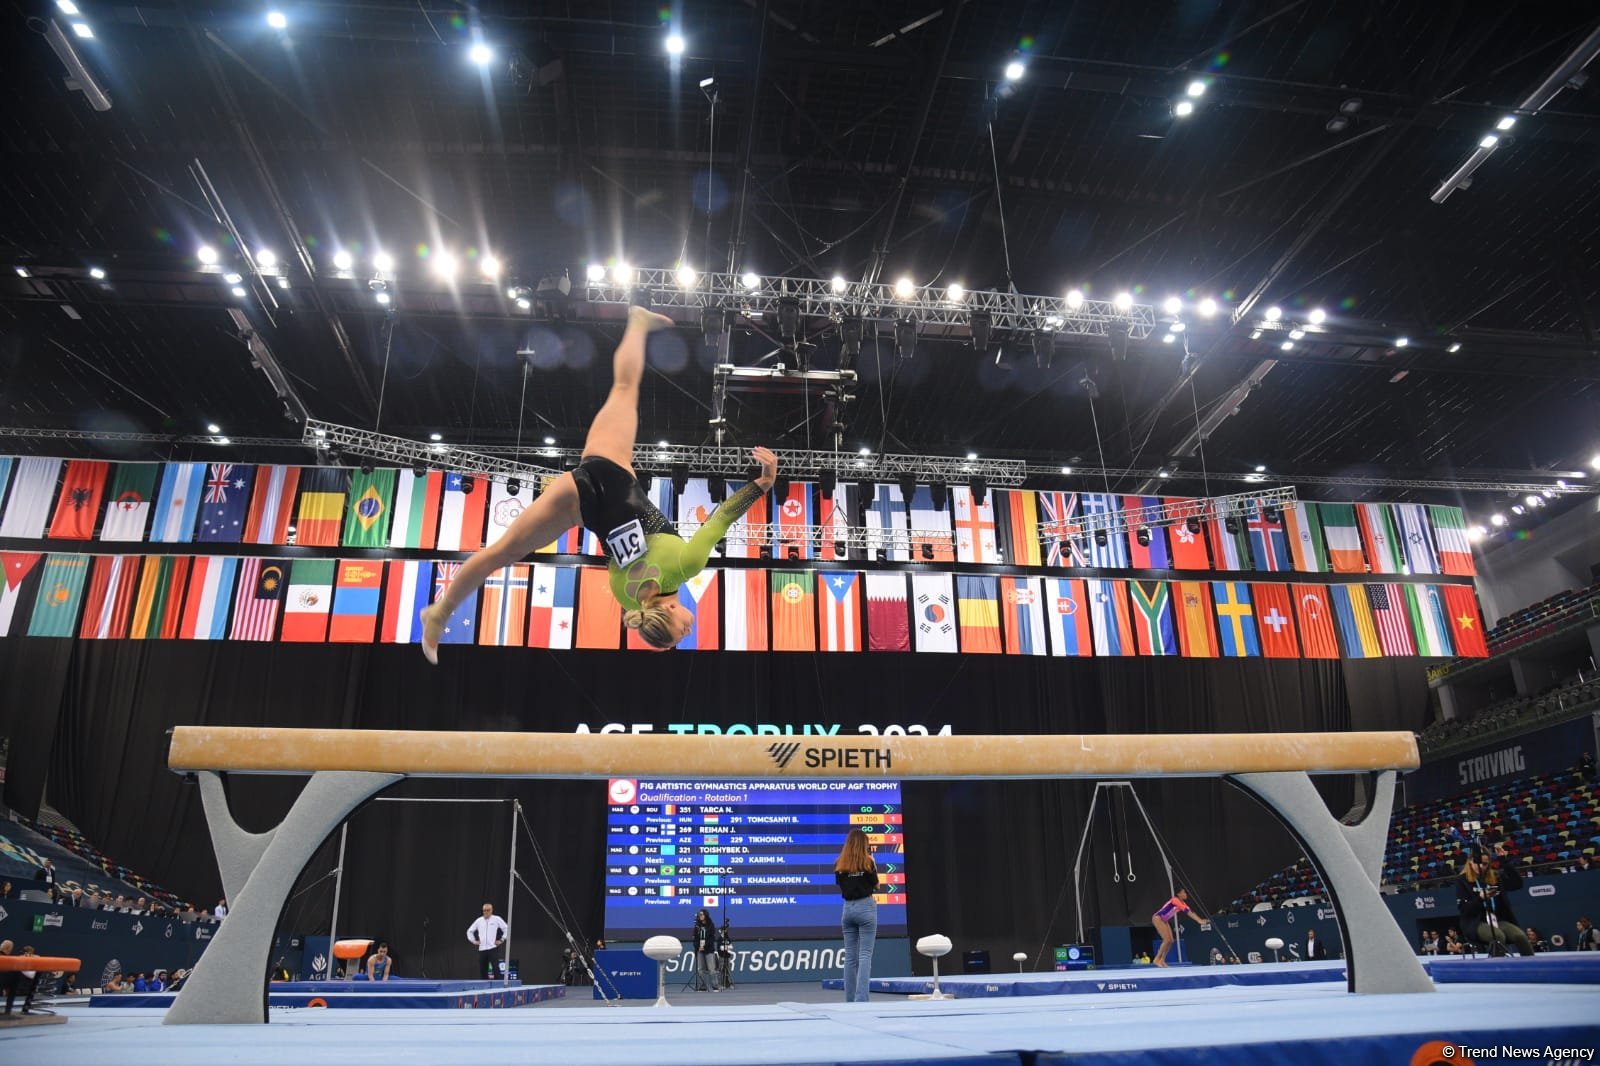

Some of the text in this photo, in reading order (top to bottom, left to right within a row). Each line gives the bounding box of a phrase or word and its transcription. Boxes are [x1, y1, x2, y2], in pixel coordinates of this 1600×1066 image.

[611, 532, 641, 565] 511
[804, 748, 892, 769] SPIETH
[1458, 745, 1526, 785] STRIVING
[640, 793, 697, 802] Qualification
[705, 793, 742, 802] Rotation
[665, 949, 846, 972] SRTSCORING
